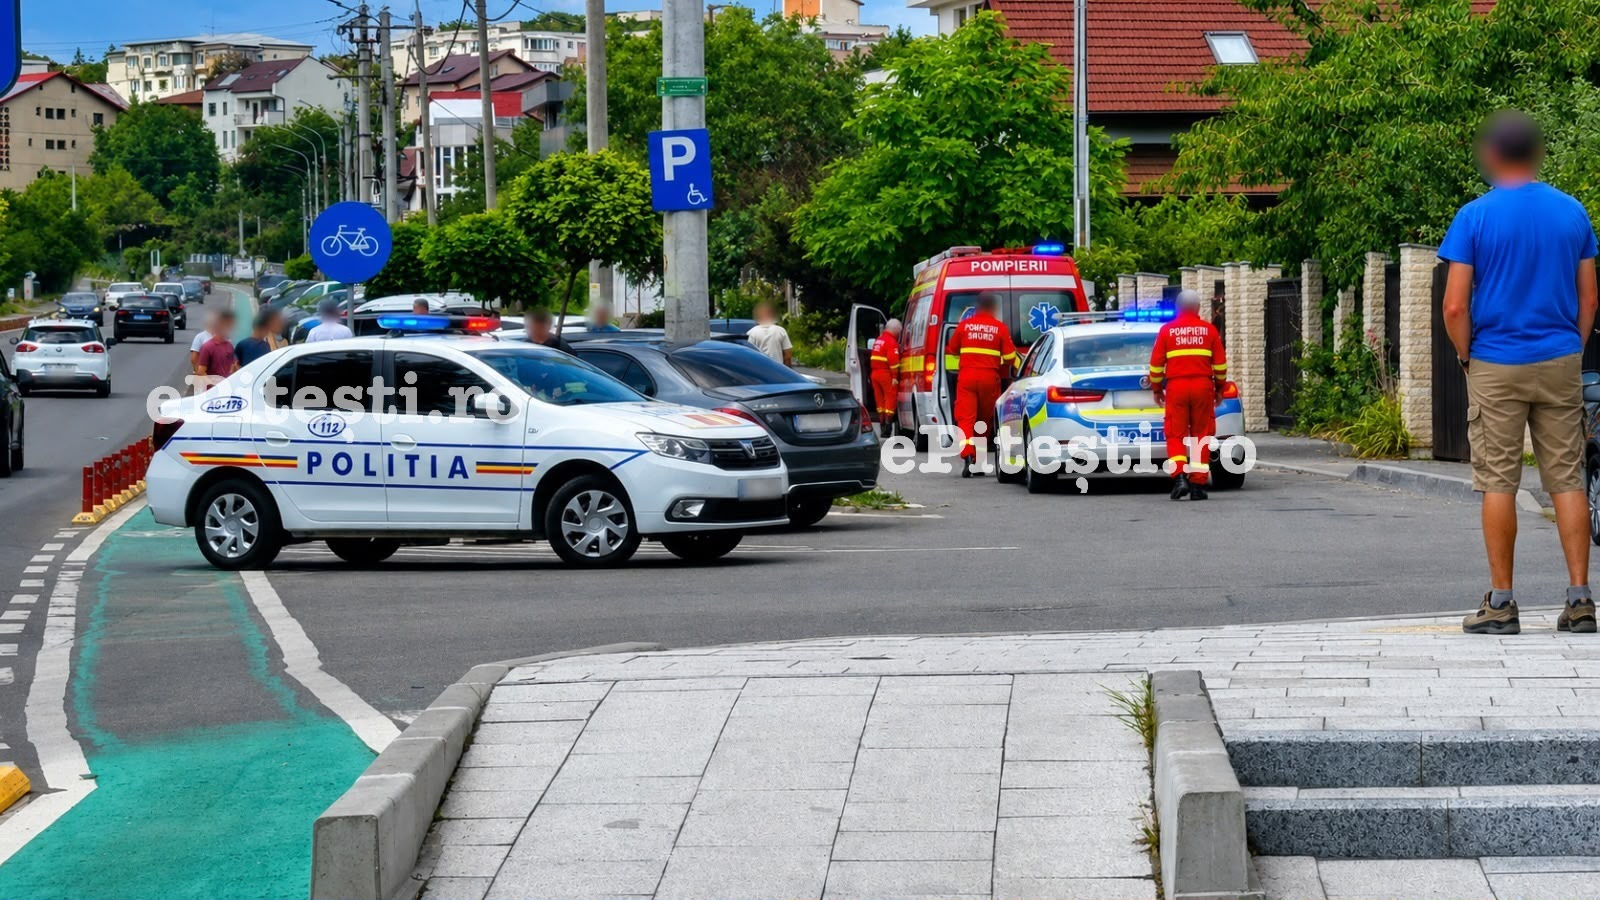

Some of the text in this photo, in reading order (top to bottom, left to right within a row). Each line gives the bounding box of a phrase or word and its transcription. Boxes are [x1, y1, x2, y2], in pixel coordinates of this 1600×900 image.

[662, 136, 696, 182] P
[971, 260, 1047, 272] POMPIERII
[321, 422, 339, 433] 112
[306, 451, 470, 480] POLITIA
